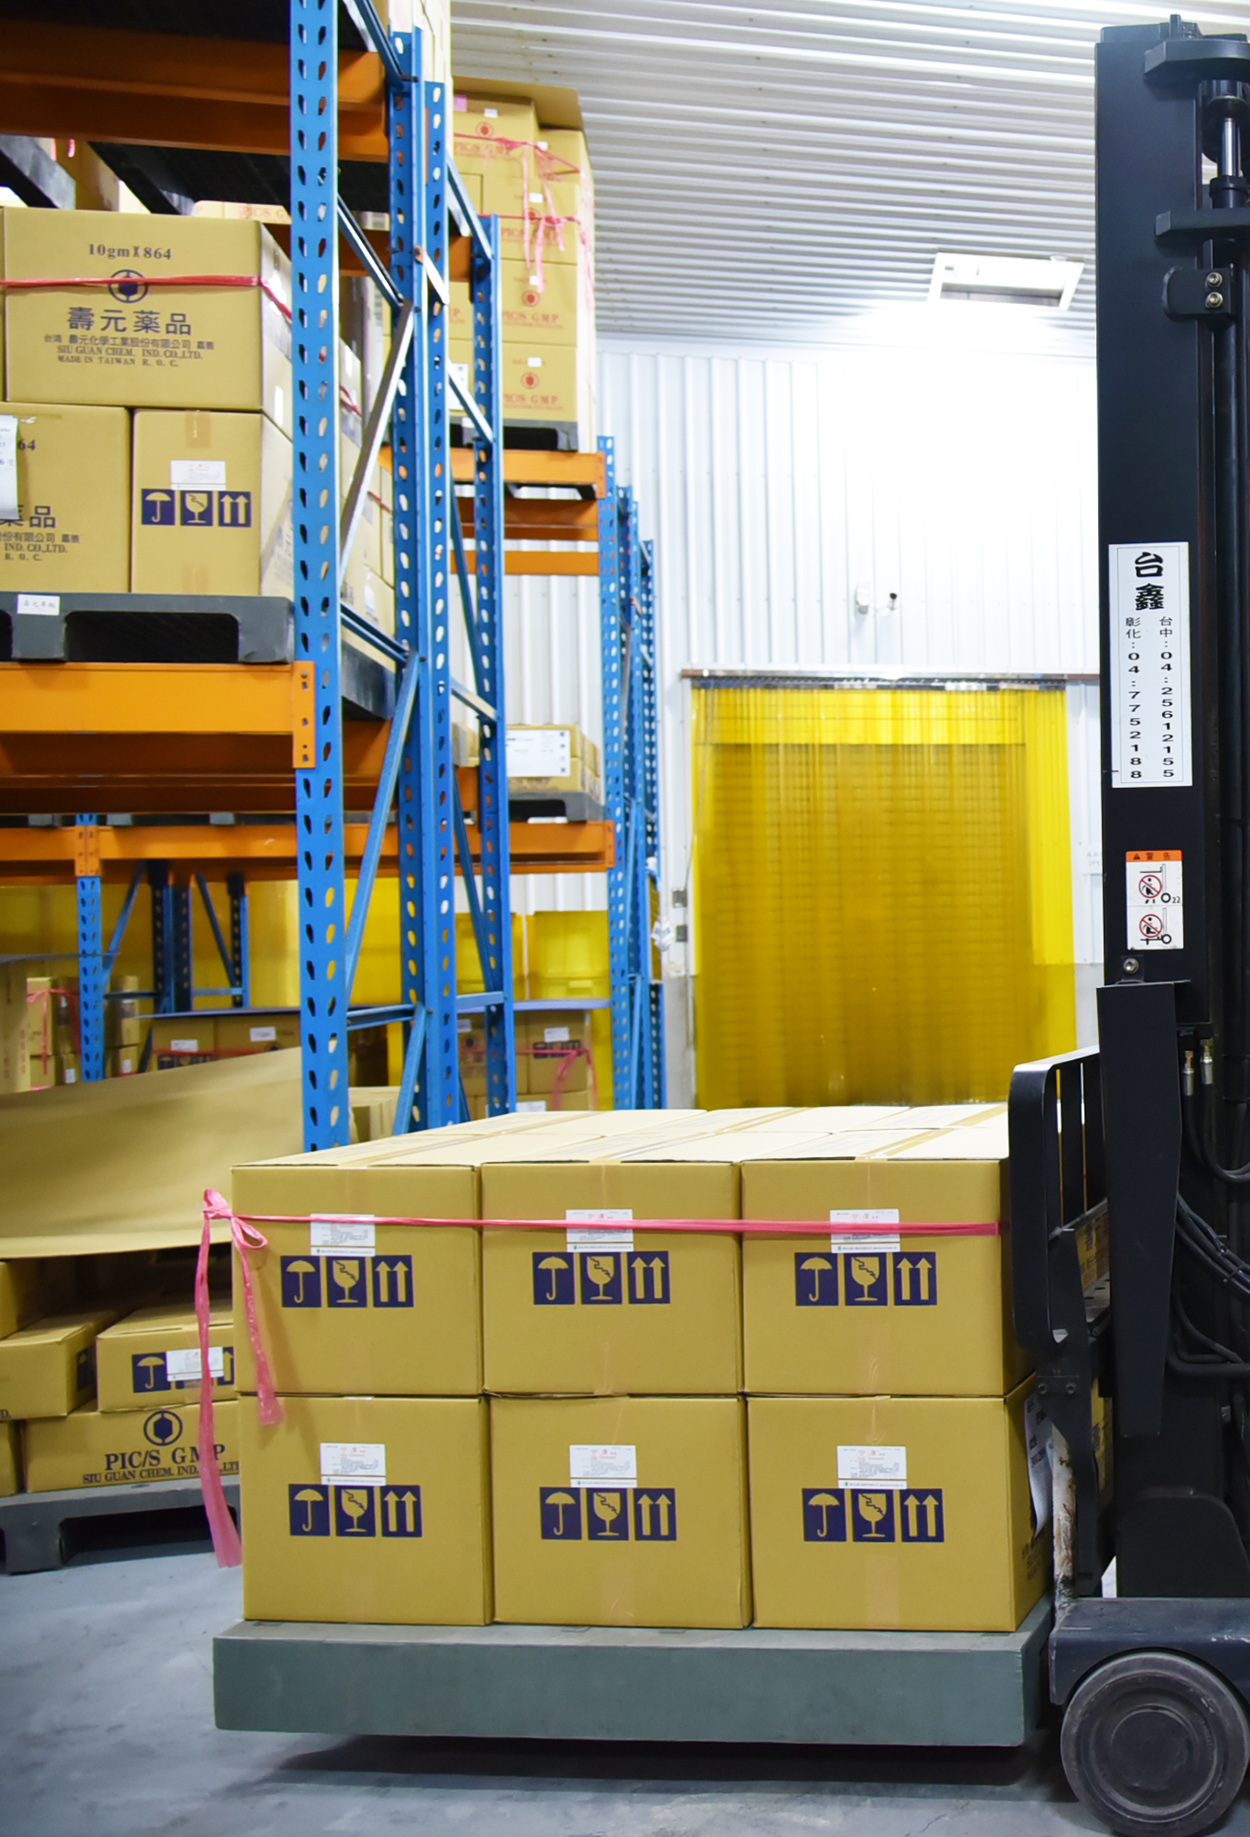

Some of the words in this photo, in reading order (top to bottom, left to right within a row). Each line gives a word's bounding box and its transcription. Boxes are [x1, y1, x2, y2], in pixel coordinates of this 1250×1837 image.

[58, 355, 82, 363] MADE
[98, 356, 135, 365] TAIWAN
[75, 346, 103, 355] GUAN
[1134, 551, 1164, 611] 台鑫
[104, 1450, 161, 1471] PIC/S
[83, 1472, 101, 1484] SIU
[104, 1469, 136, 1482] GUAN
[139, 1467, 174, 1479] CHEM.
[178, 1465, 199, 1475] IND.
